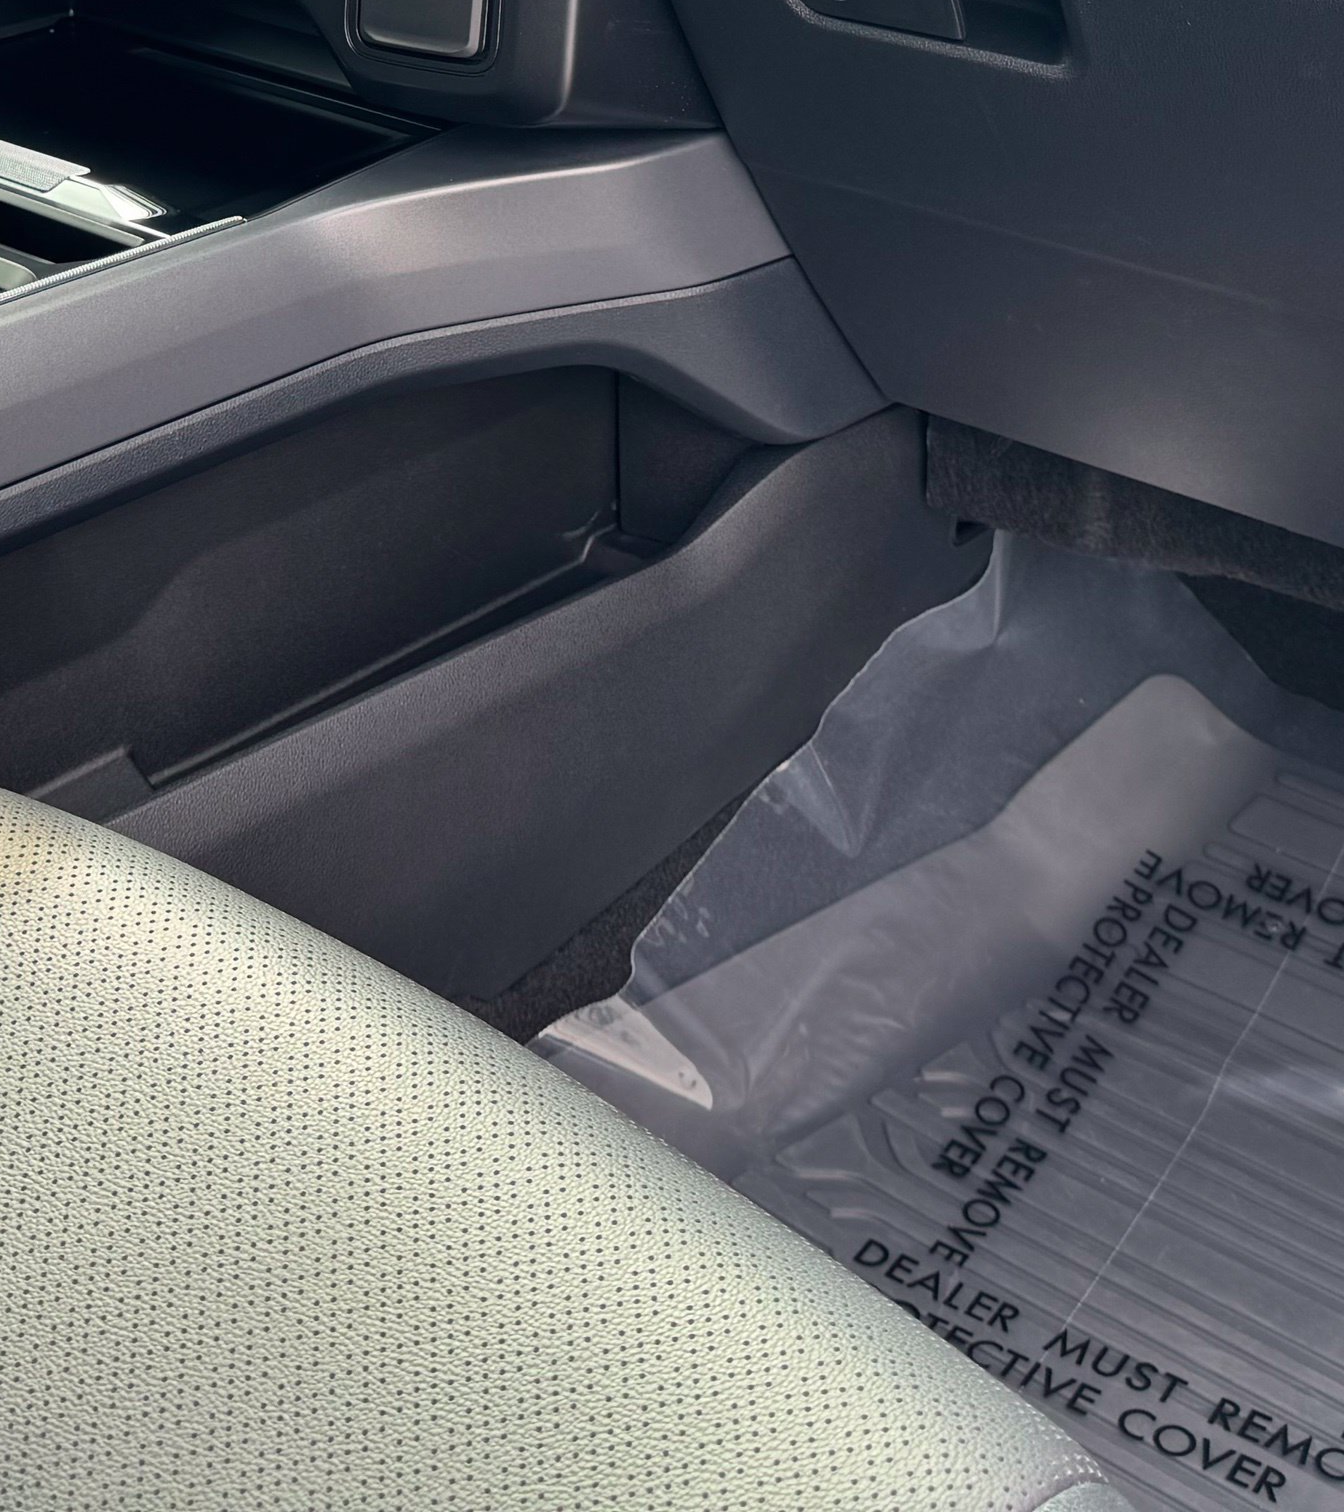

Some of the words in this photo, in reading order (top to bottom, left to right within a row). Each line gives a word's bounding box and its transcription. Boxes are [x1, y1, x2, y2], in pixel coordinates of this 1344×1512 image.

[1132, 847, 1308, 952] REMOVE
[1012, 878, 1154, 1072] PROTECTIVE
[1102, 902, 1199, 1027] DEALER
[931, 1074, 1026, 1180] COVER
[1035, 1034, 1116, 1135] MUST
[928, 1136, 1049, 1269] REMOVE
[852, 1236, 1021, 1335] DEALER
[1042, 1325, 1189, 1405] MUST
[1116, 1407, 1289, 1505] COVER
